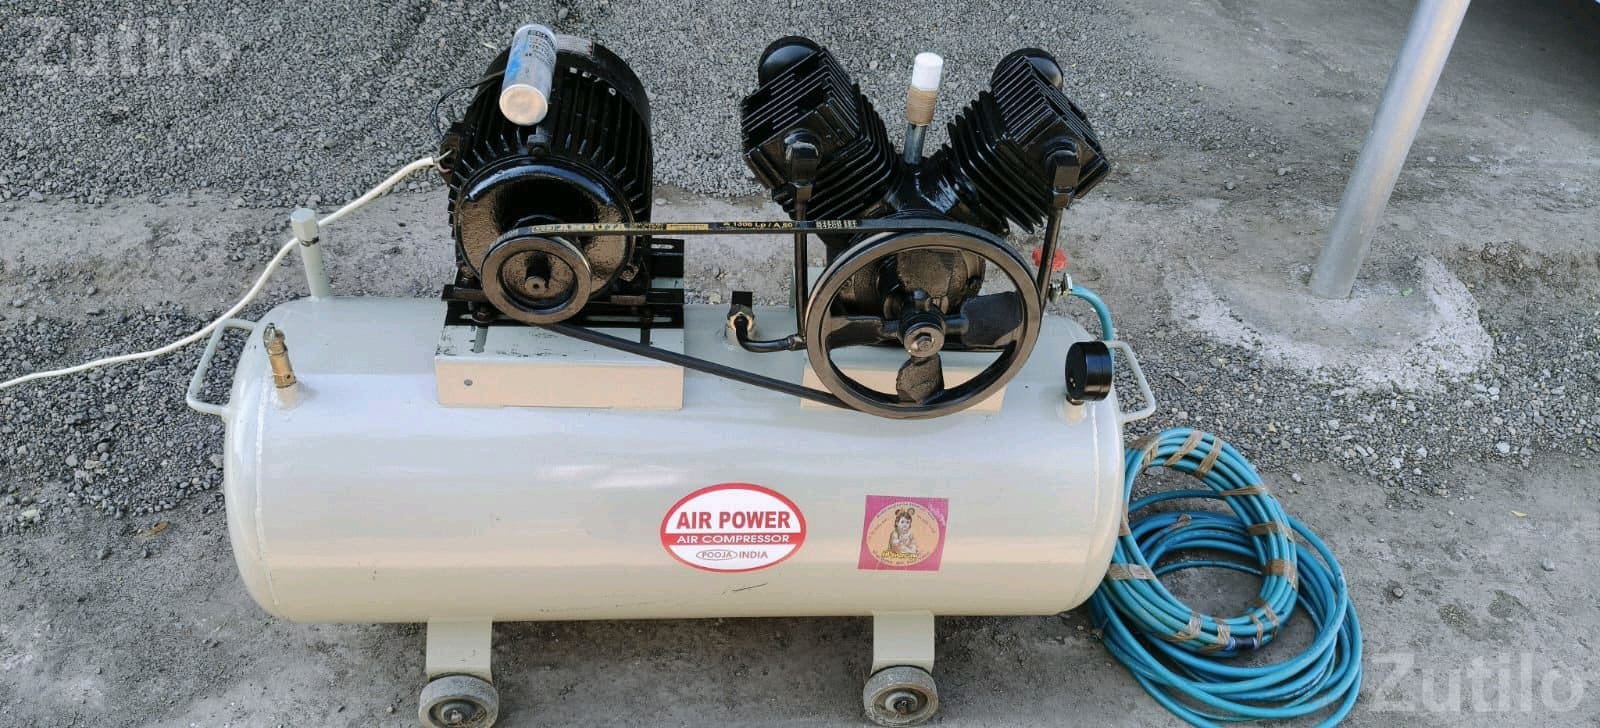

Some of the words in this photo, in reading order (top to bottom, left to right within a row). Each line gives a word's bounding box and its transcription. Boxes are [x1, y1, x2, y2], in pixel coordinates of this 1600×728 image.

[677, 511, 712, 529] AIR
[719, 511, 790, 529] POWER
[677, 535, 698, 544] AIR
[702, 534, 790, 544] COMPRESSOR
[702, 551, 732, 559] POOJA
[739, 551, 768, 559] INDIA
